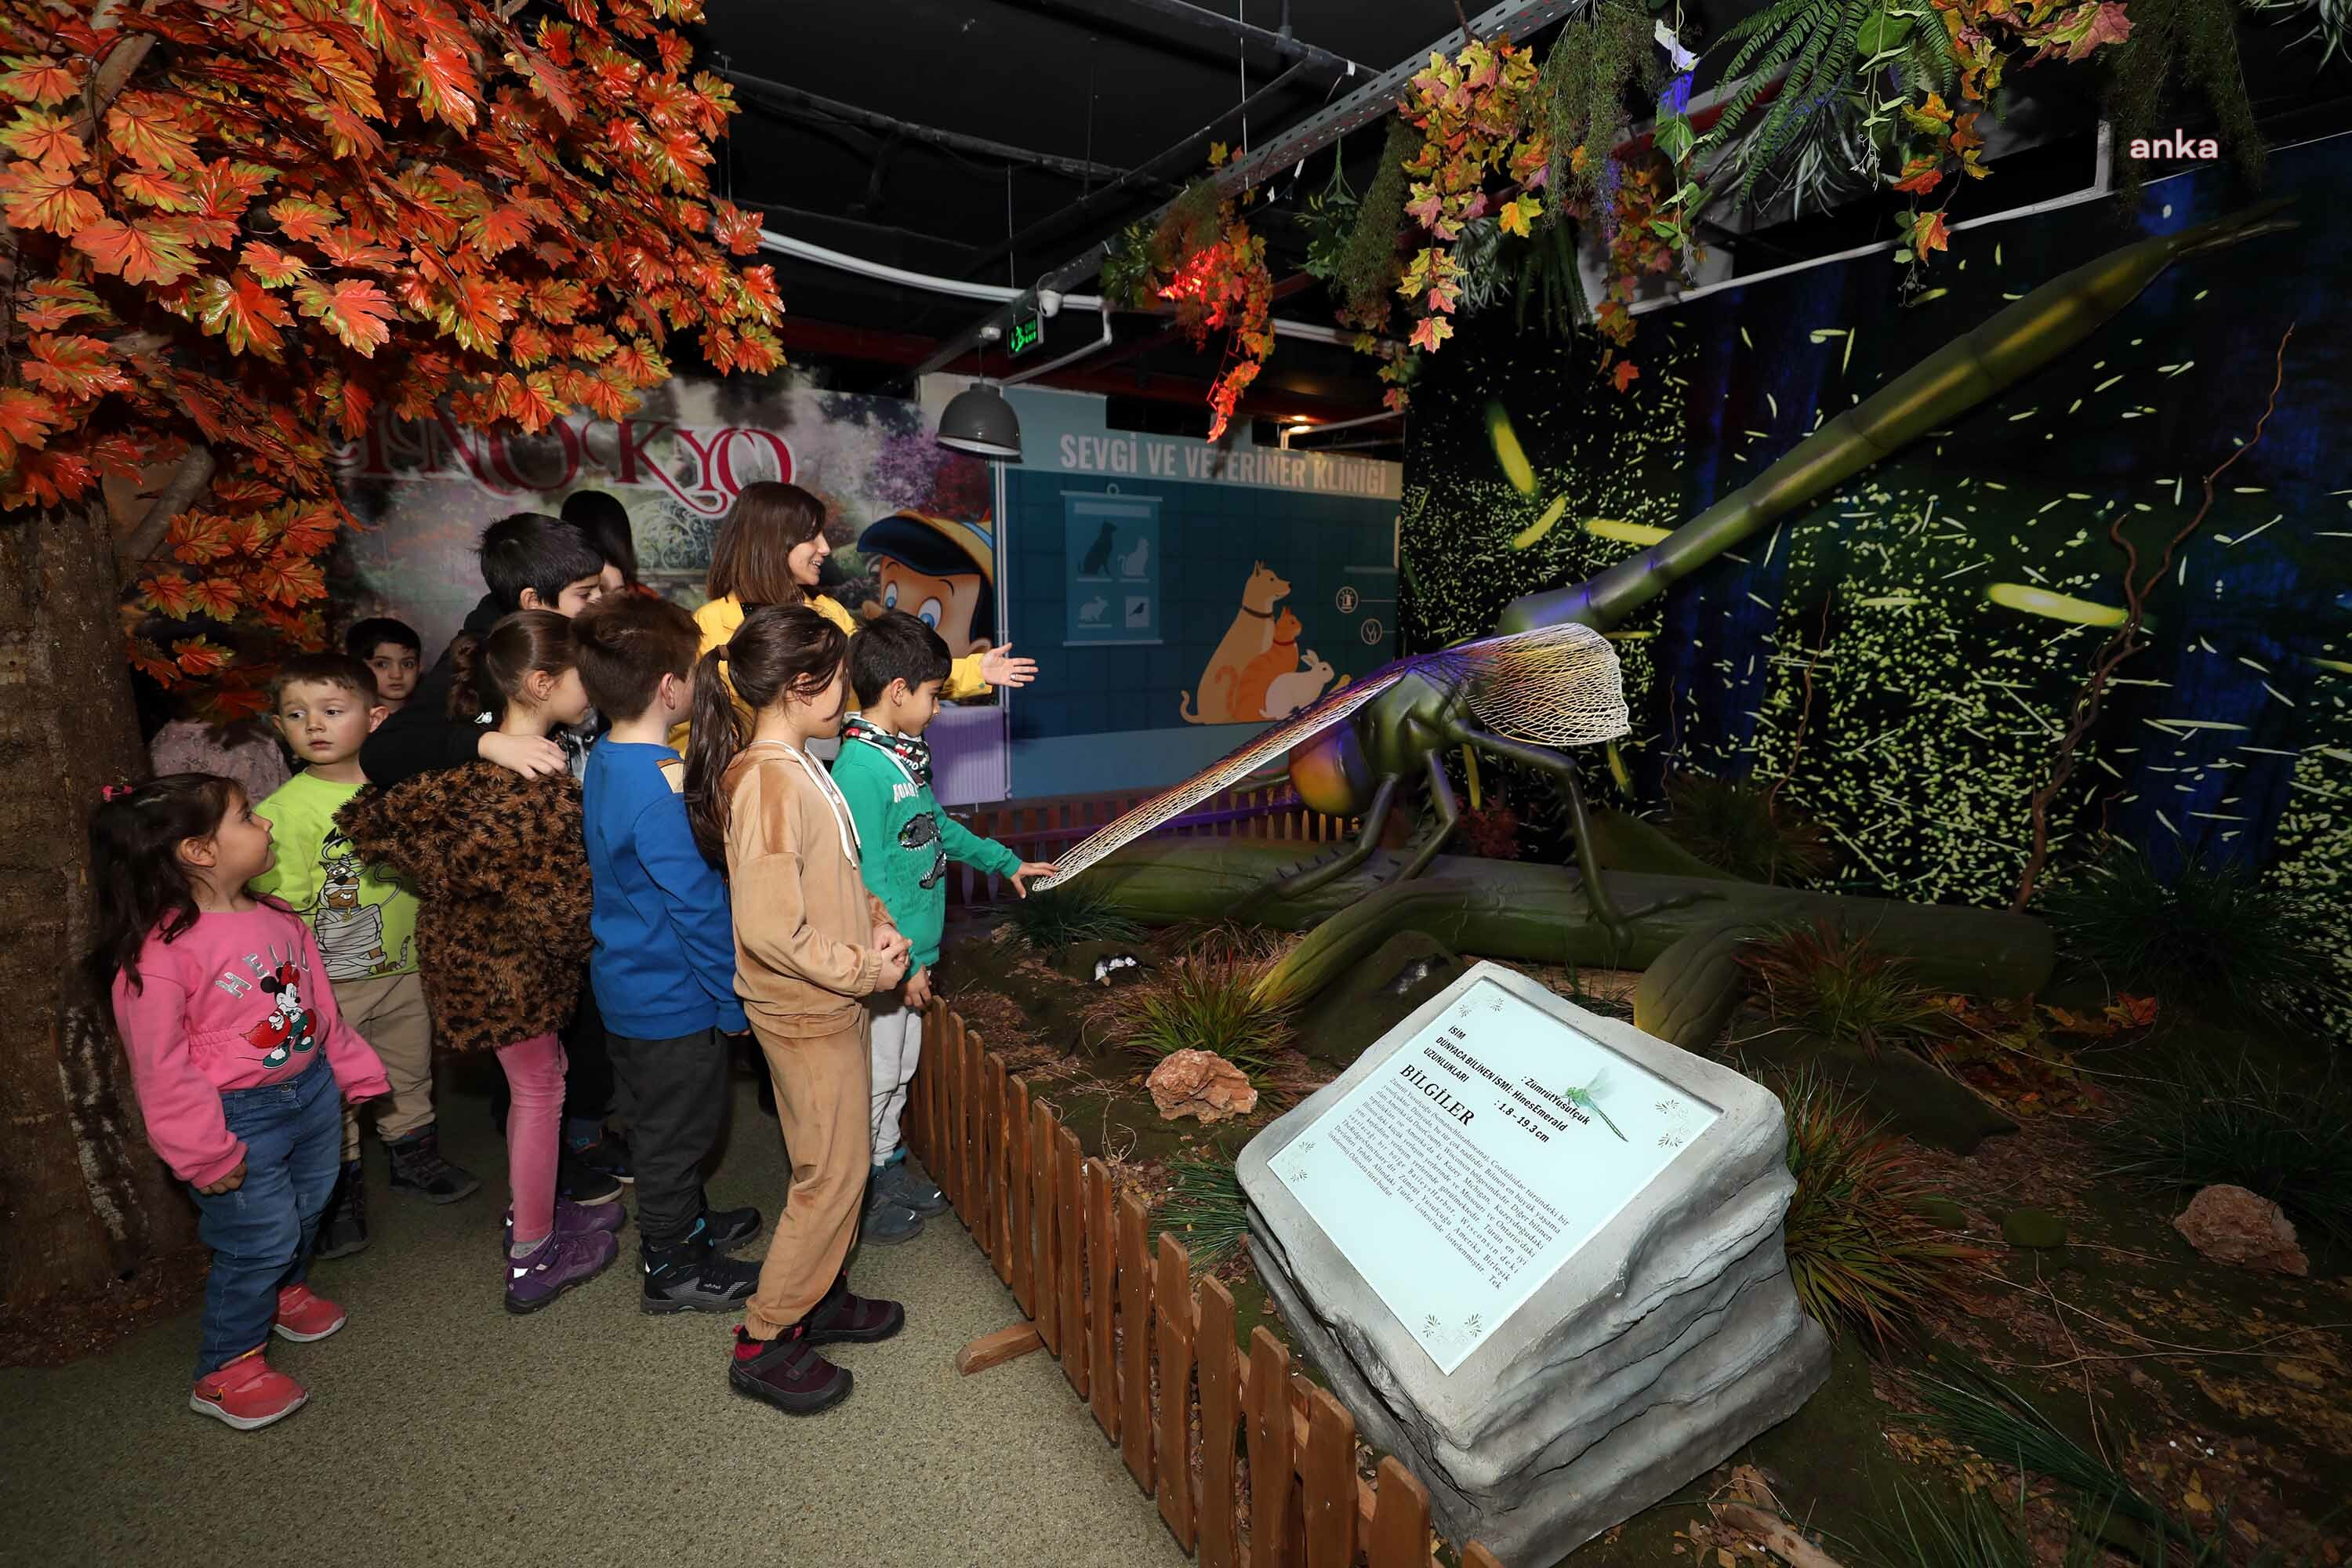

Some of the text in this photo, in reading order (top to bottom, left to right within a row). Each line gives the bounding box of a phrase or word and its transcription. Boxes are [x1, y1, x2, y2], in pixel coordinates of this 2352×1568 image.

[1060, 432, 1386, 495] SEVGİ VE VETERİNER KLİNİĞİ
[1436, 1036, 1468, 1062] DÜNYACA
[1465, 1057, 1496, 1080] BİLİNEN
[1399, 1064, 1475, 1127] BİLGİLER
[1424, 1047, 1470, 1083] UZUNLUKLARI
[1498, 1104, 1515, 1116] 1.8
[1517, 1117, 1538, 1134] 19.3
[1535, 1131, 1550, 1143] cm
[1433, 1126, 1442, 1135] bu
[1441, 1133, 1451, 1142] tür
[1450, 1141, 1461, 1151] çok
[1484, 1168, 1506, 1189] Bilinen
[1515, 1192, 1536, 1214] büyük
[1535, 1212, 1561, 1235] yaşama
[1460, 1189, 1487, 1214] Missouri
[1487, 1213, 1496, 1221] ve
[1511, 1204, 1530, 1222] Diğer
[1529, 1219, 1552, 1243] bilinen
[1558, 1214, 1570, 1226] bir
[1454, 1228, 1481, 1254] Amerika
[1483, 1254, 1511, 1282] Birleşik
[1505, 1246, 1515, 1254] en
[1489, 1275, 1502, 1290] Tek
